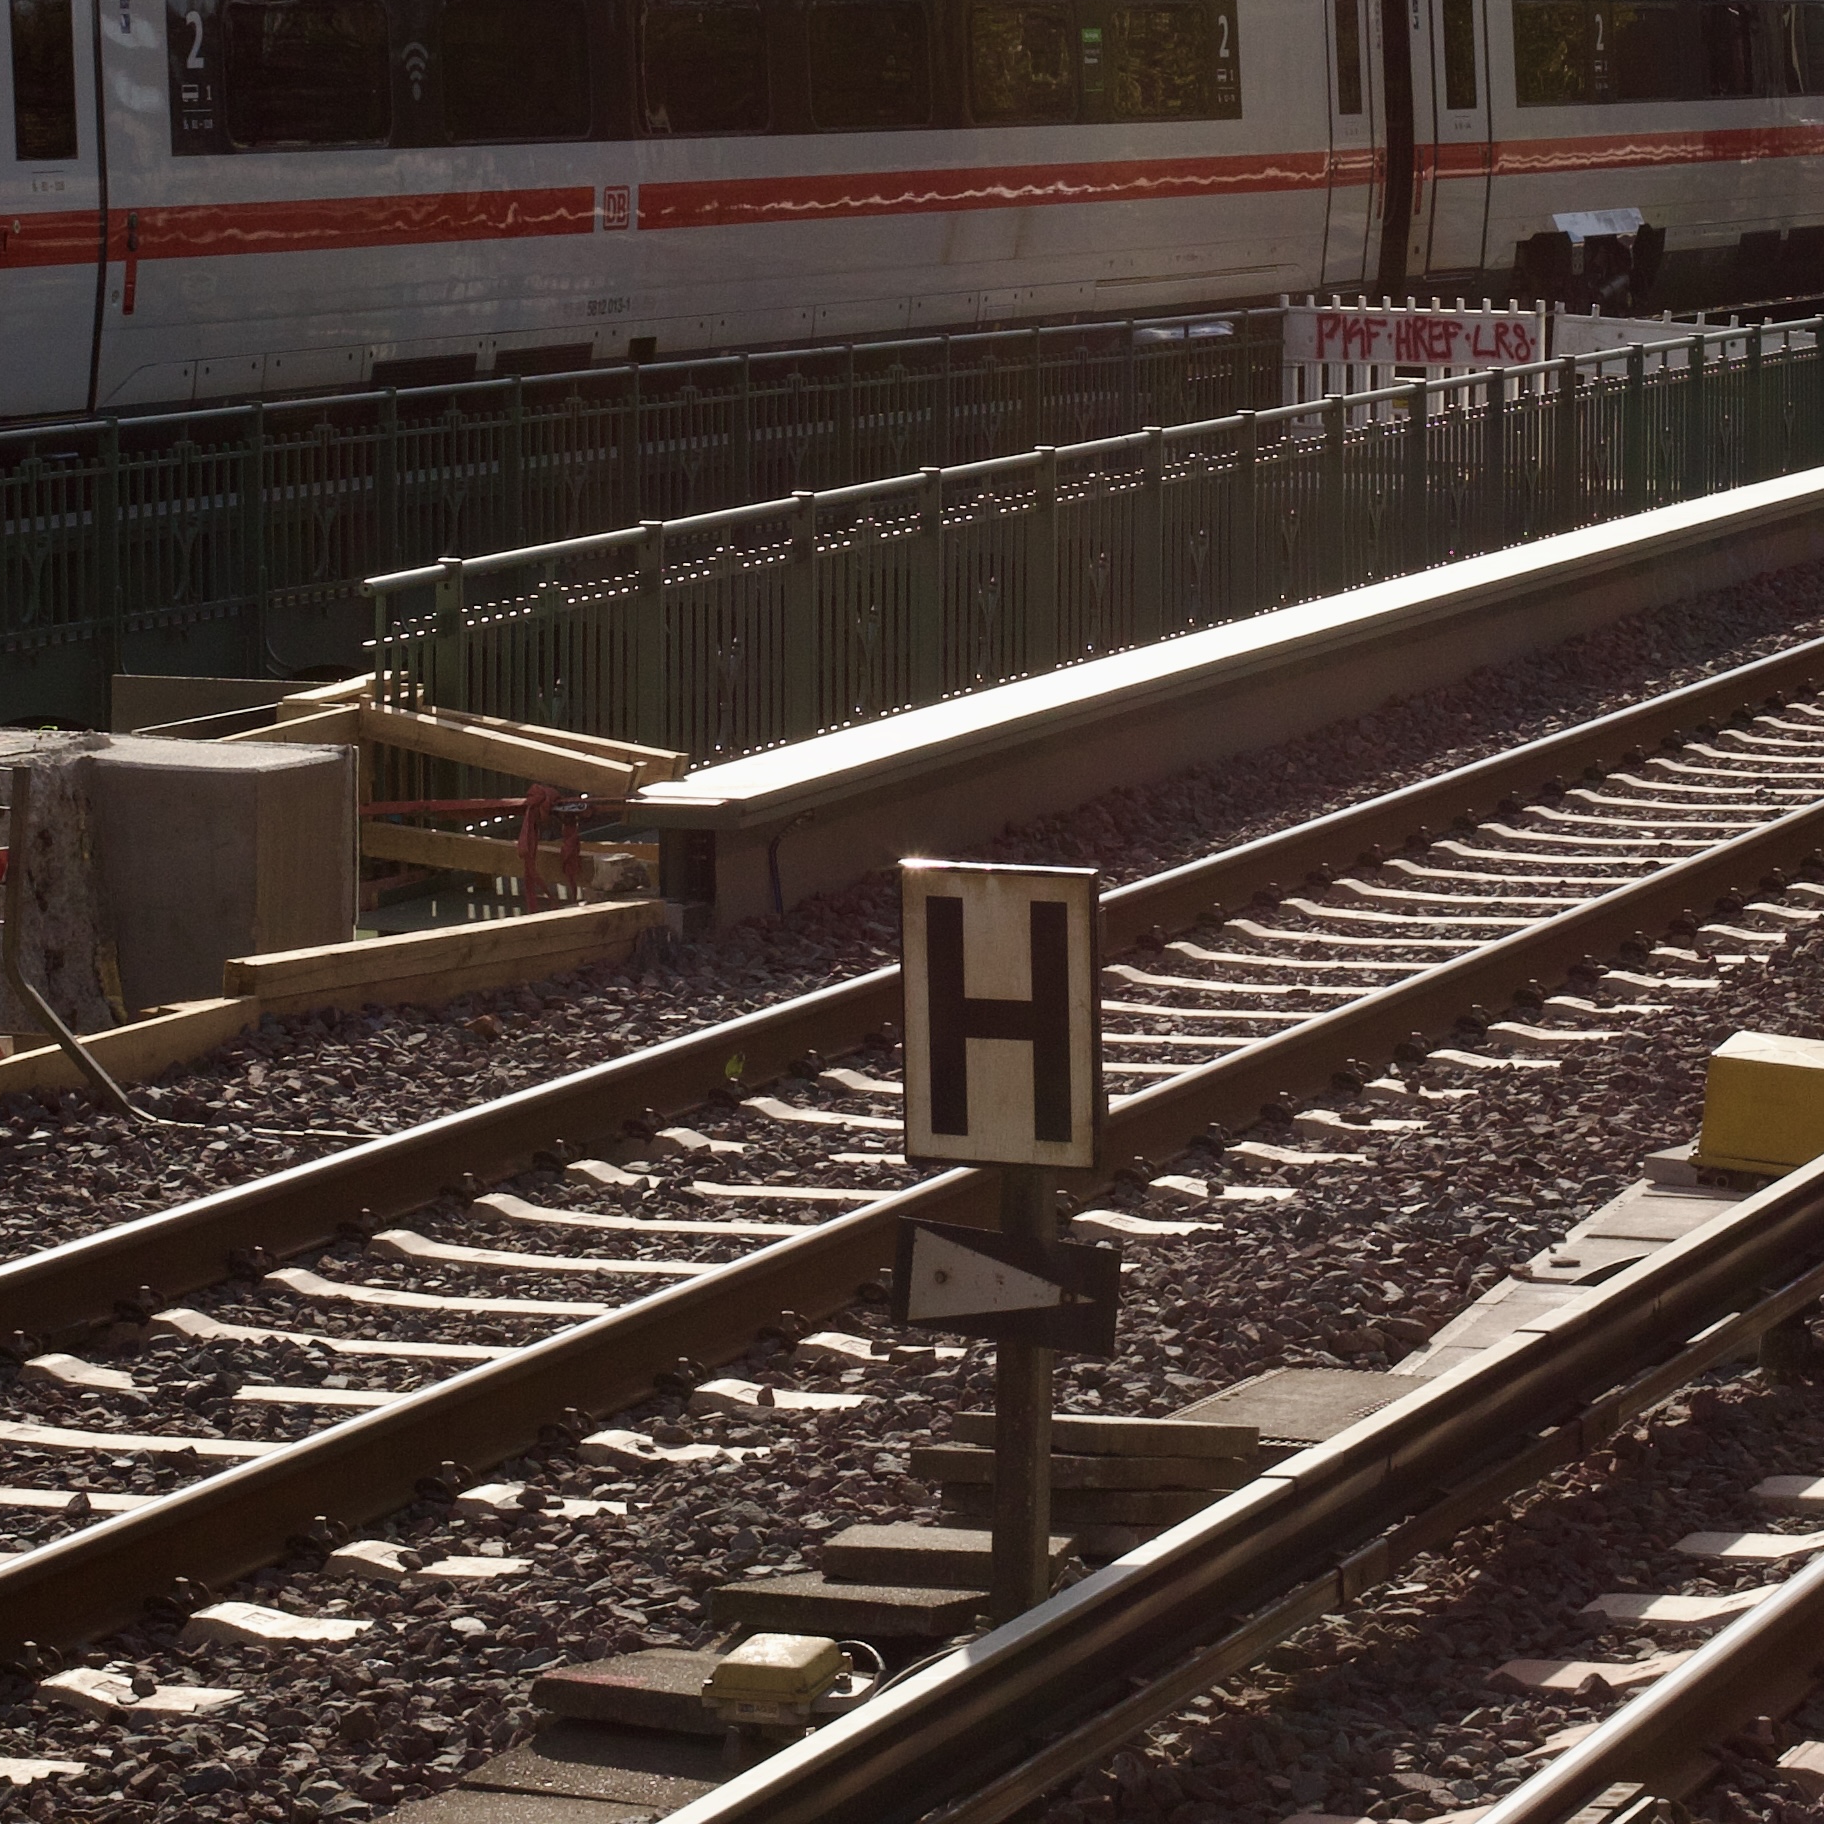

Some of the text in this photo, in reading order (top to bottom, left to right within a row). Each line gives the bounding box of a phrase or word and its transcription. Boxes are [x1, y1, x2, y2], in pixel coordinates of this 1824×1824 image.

[185, 11, 205, 69] 2
[1218, 15, 1230, 58] 2
[1595, 13, 1605, 51] 2
[606, 190, 627, 226] DB
[926, 896, 1072, 1142] H
